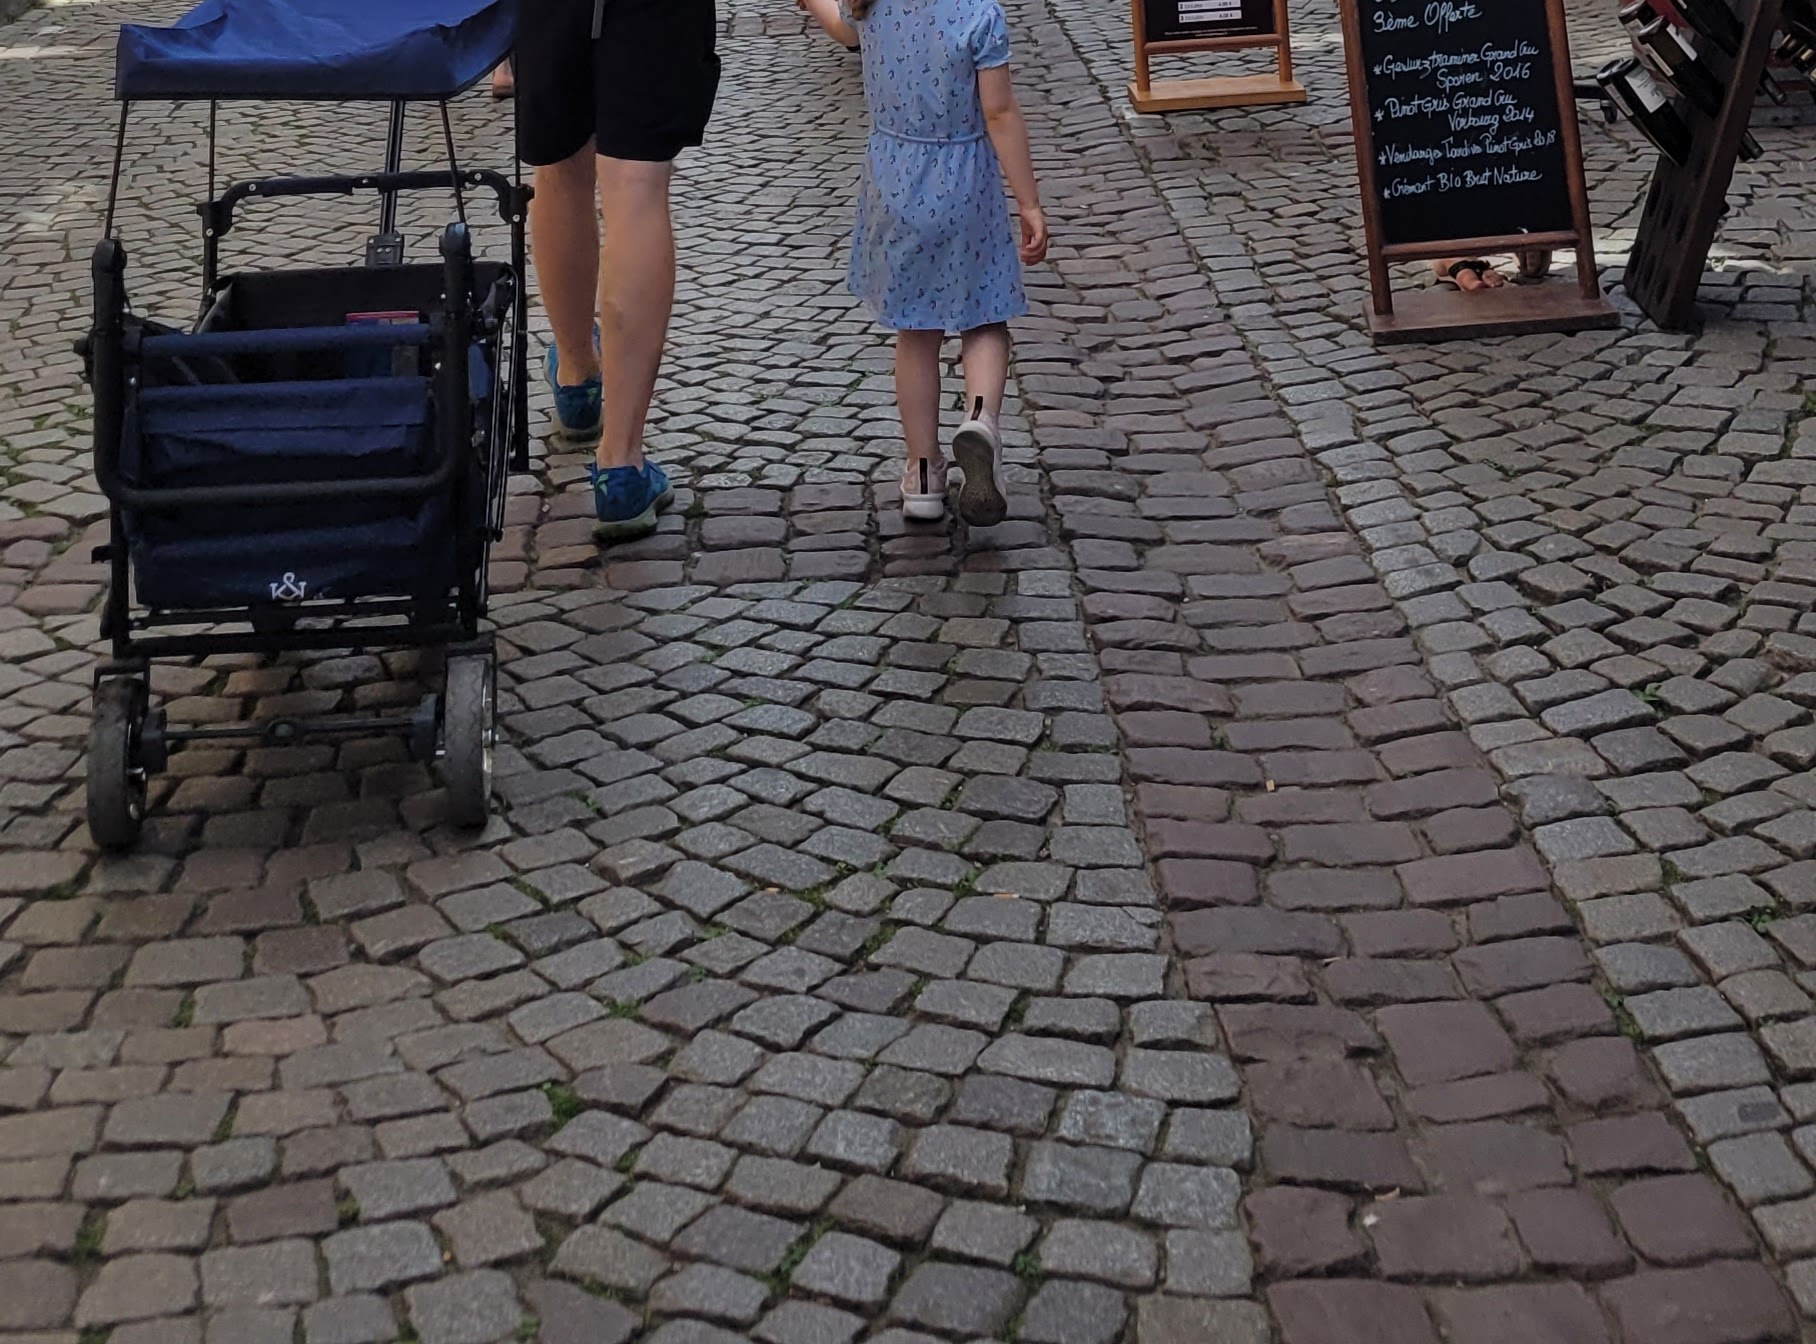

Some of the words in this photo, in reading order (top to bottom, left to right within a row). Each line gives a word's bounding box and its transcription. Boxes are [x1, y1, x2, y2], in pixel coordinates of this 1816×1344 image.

[1373, 10, 1420, 33] 3ème
[1424, 1, 1483, 34] Offerte
[1480, 39, 1519, 68] Grand
[1489, 62, 1532, 82] 2016
[1384, 96, 1422, 119] Pinot
[1421, 94, 1451, 119] Gris
[1452, 88, 1493, 114] Grand
[1502, 105, 1535, 123] 2014
[1479, 133, 1510, 154] Pinot
[1509, 137, 1533, 157] Gris
[1437, 167, 1462, 192] Bio
[1463, 168, 1493, 188] Brut
[1493, 163, 1543, 185] Nature
